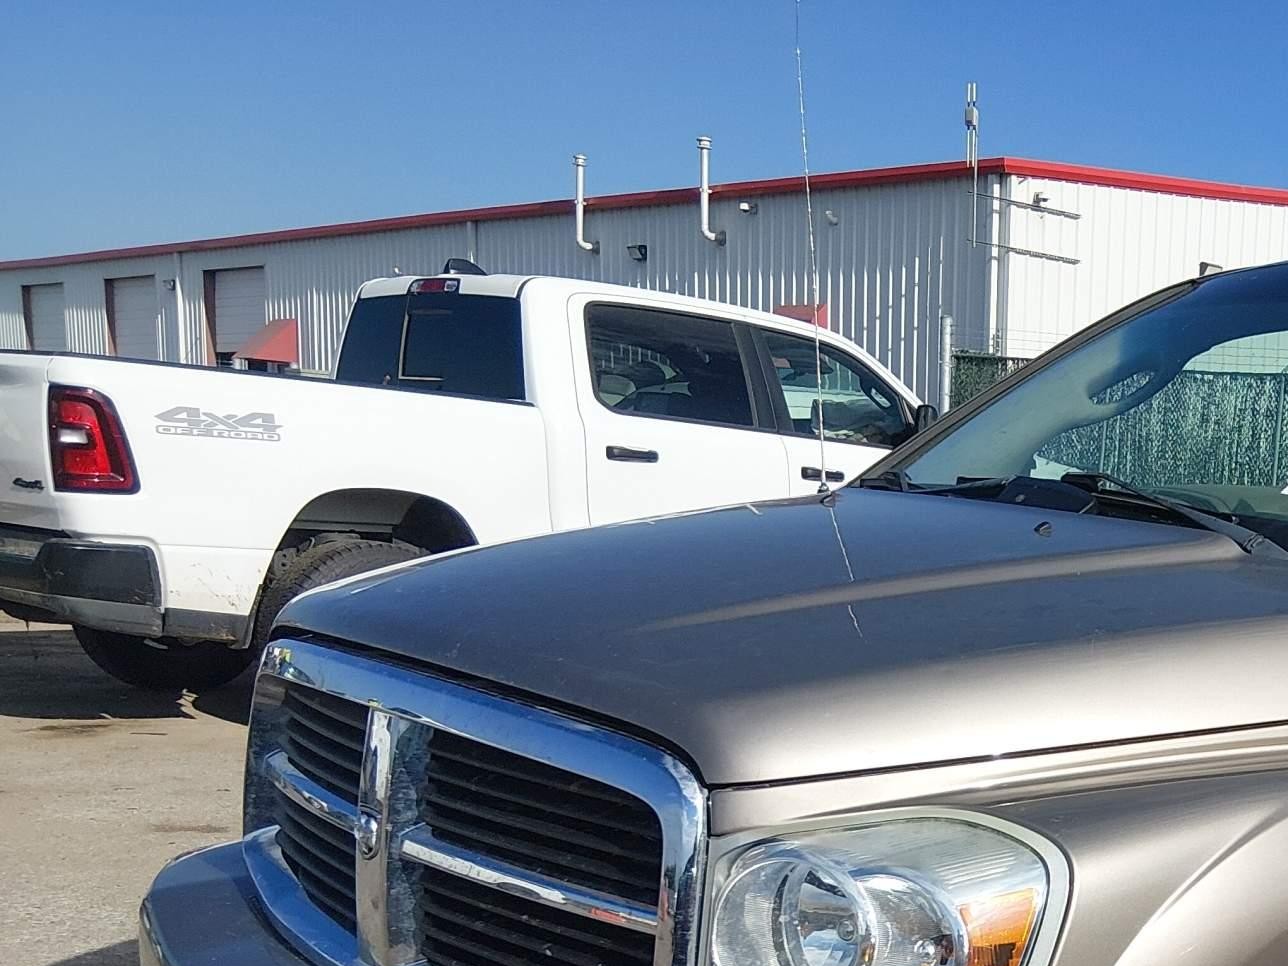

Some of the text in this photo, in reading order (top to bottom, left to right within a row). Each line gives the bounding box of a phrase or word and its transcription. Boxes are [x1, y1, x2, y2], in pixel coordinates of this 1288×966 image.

[154, 406, 284, 432] 4x4
[158, 426, 279, 441] OFF ROAD
